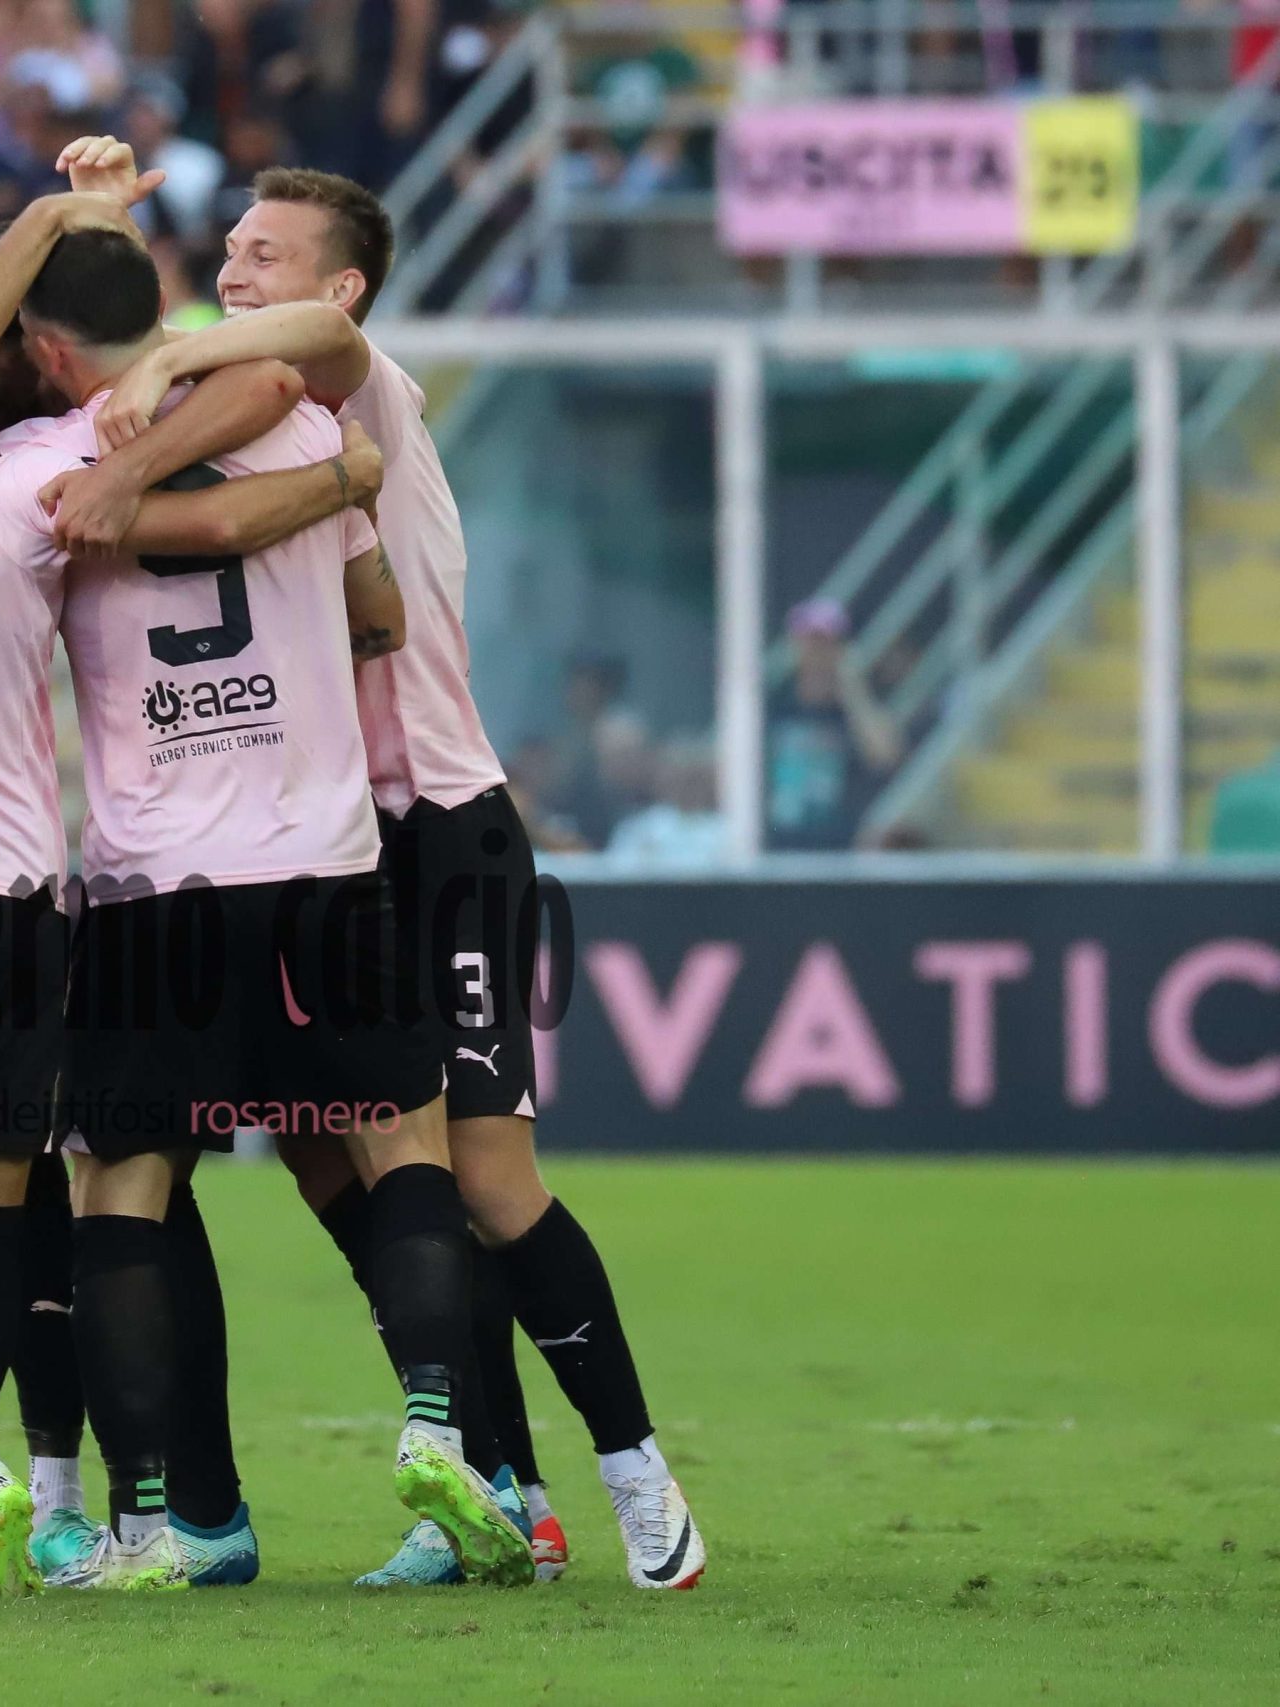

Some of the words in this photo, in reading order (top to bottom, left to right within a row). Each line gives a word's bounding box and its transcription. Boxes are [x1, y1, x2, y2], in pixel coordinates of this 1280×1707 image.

[190, 673, 277, 719] a29
[150, 746, 187, 768] ENERGY
[190, 738, 233, 757] SERVICE
[237, 731, 285, 749] COMPANY
[450, 952, 495, 1028] 3
